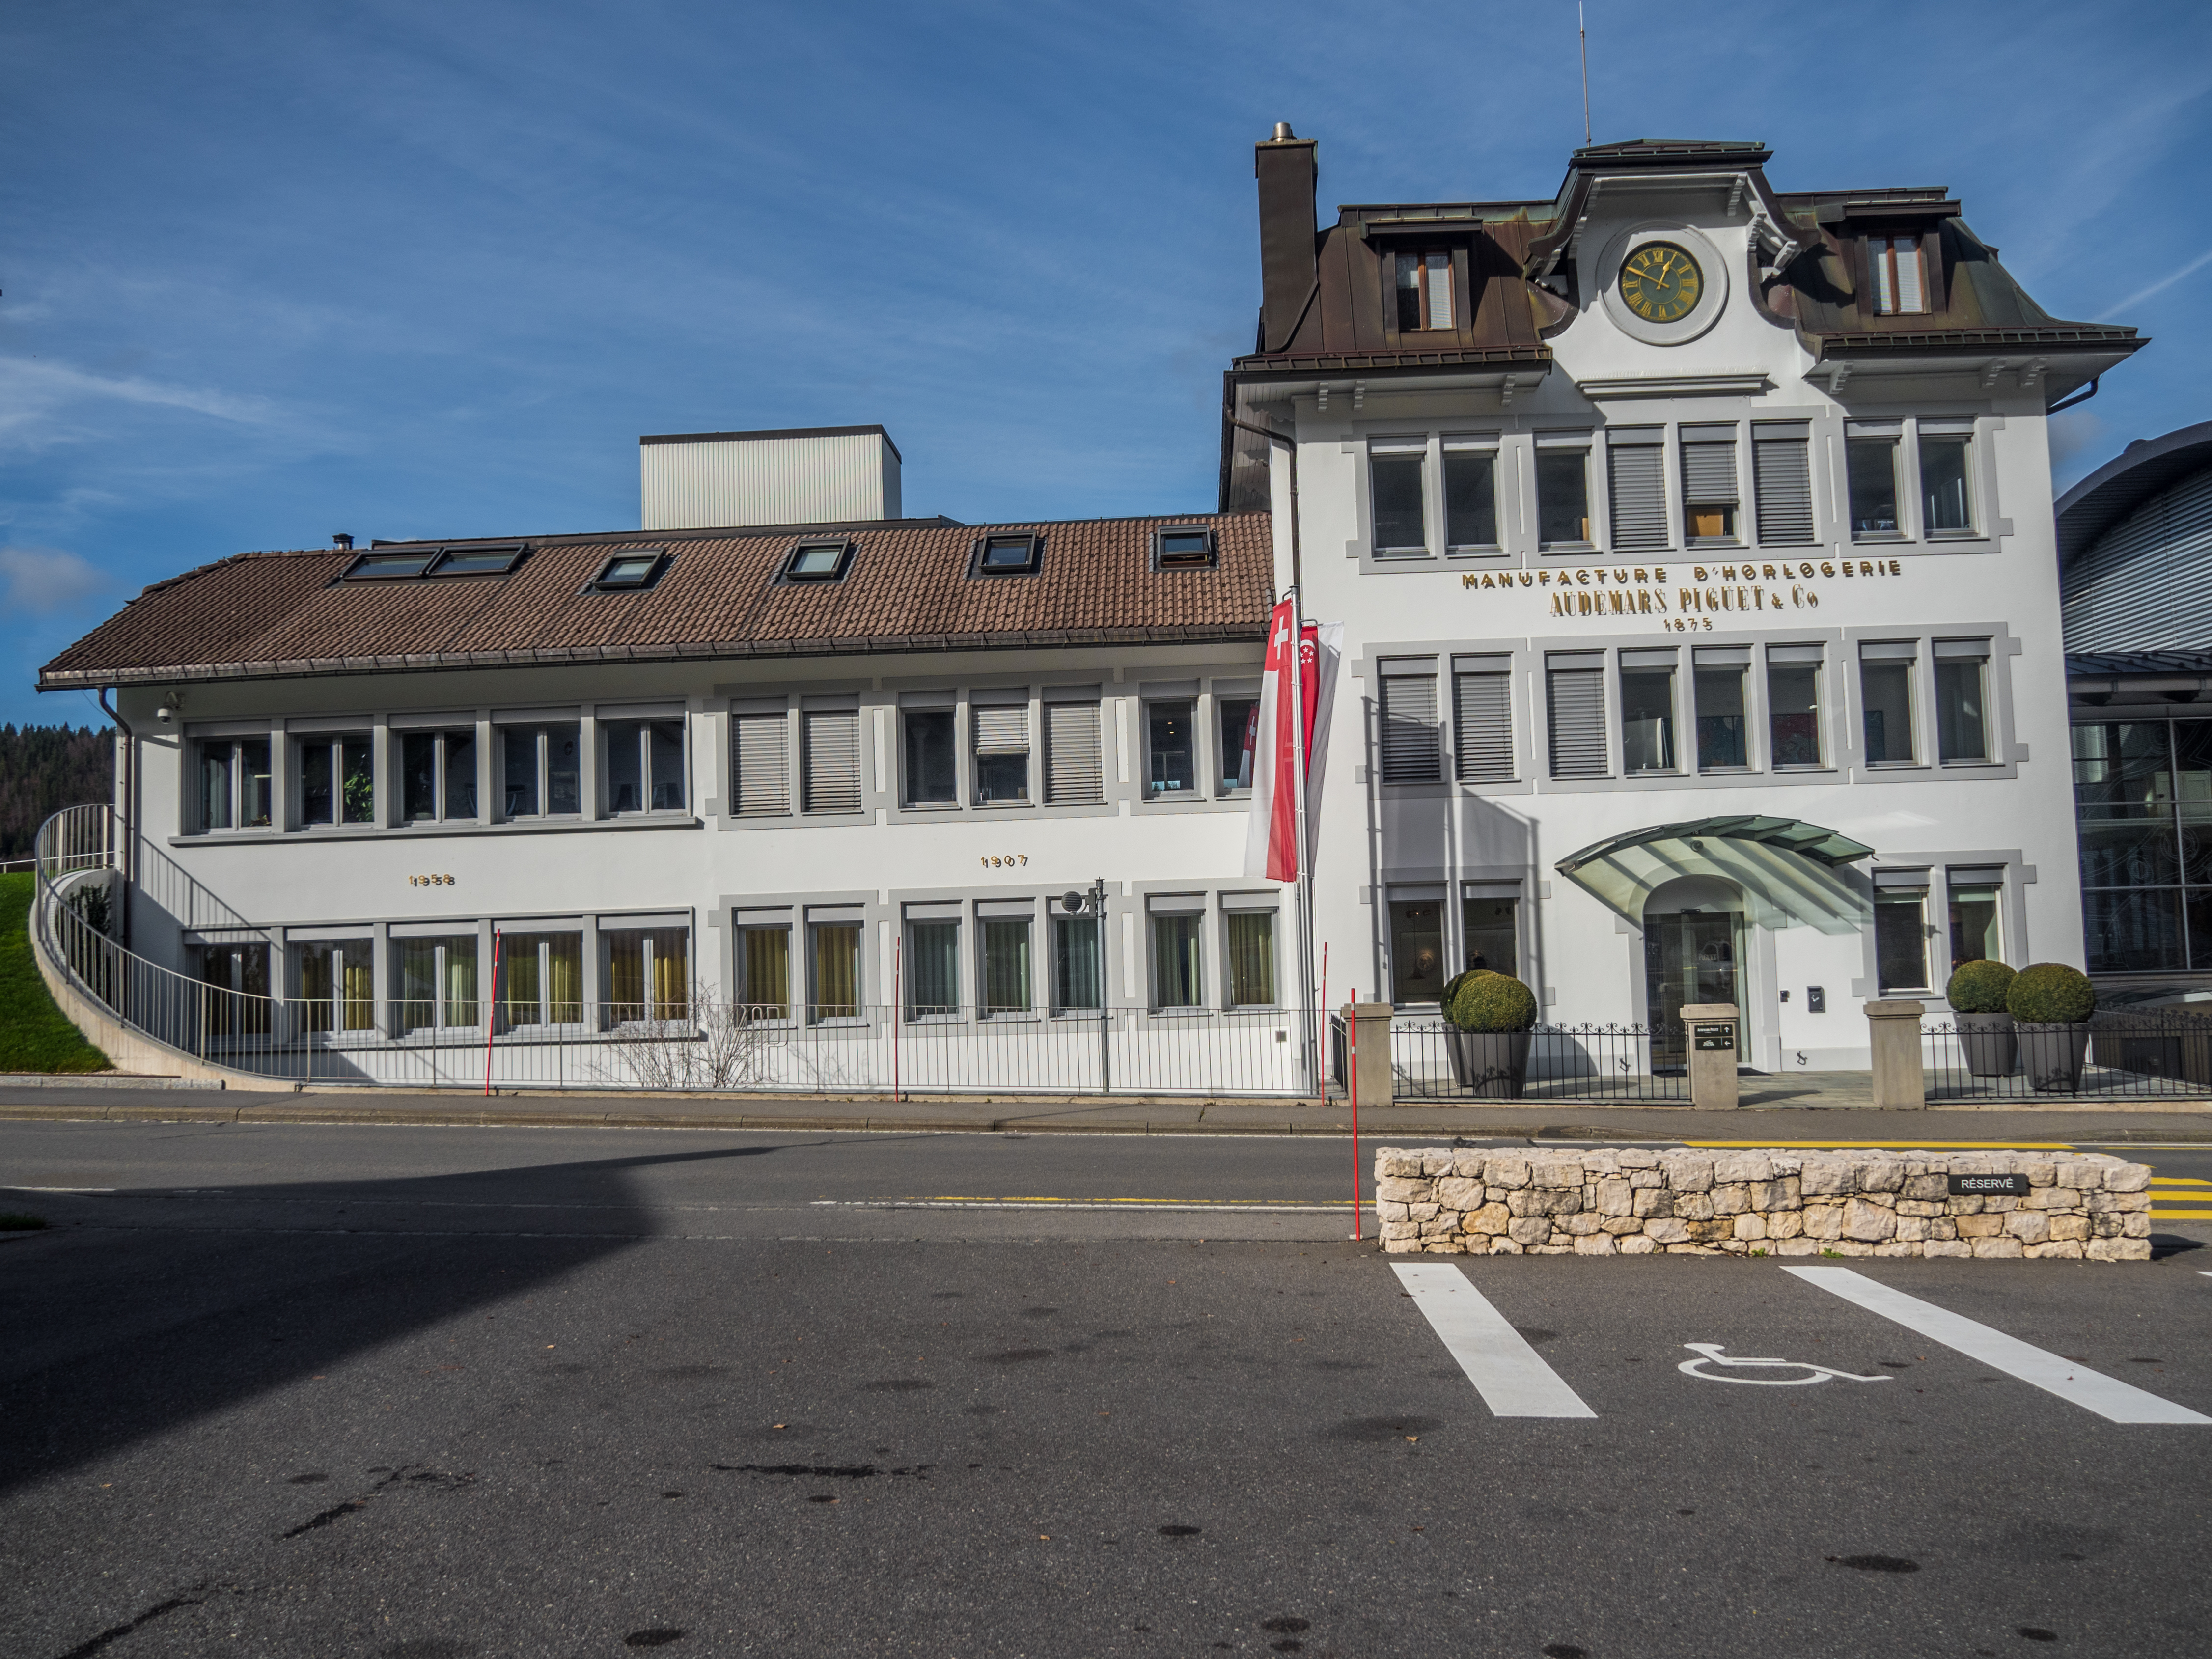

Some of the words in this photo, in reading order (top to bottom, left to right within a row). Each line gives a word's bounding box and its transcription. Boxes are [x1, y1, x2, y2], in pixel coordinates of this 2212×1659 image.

[1462, 568, 1665, 588] MANUFACTURE
[1694, 560, 1899, 580] D'HORLOGERIE
[1550, 588, 1667, 615] AUDEMARS
[1679, 585, 1763, 611] PIGUET
[1771, 593, 1782, 608] &
[1663, 617, 1712, 630] 1875
[981, 855, 1026, 867] 1907
[409, 874, 454, 886] 1958
[1961, 1177, 2014, 1188] RÉSERVÉ
